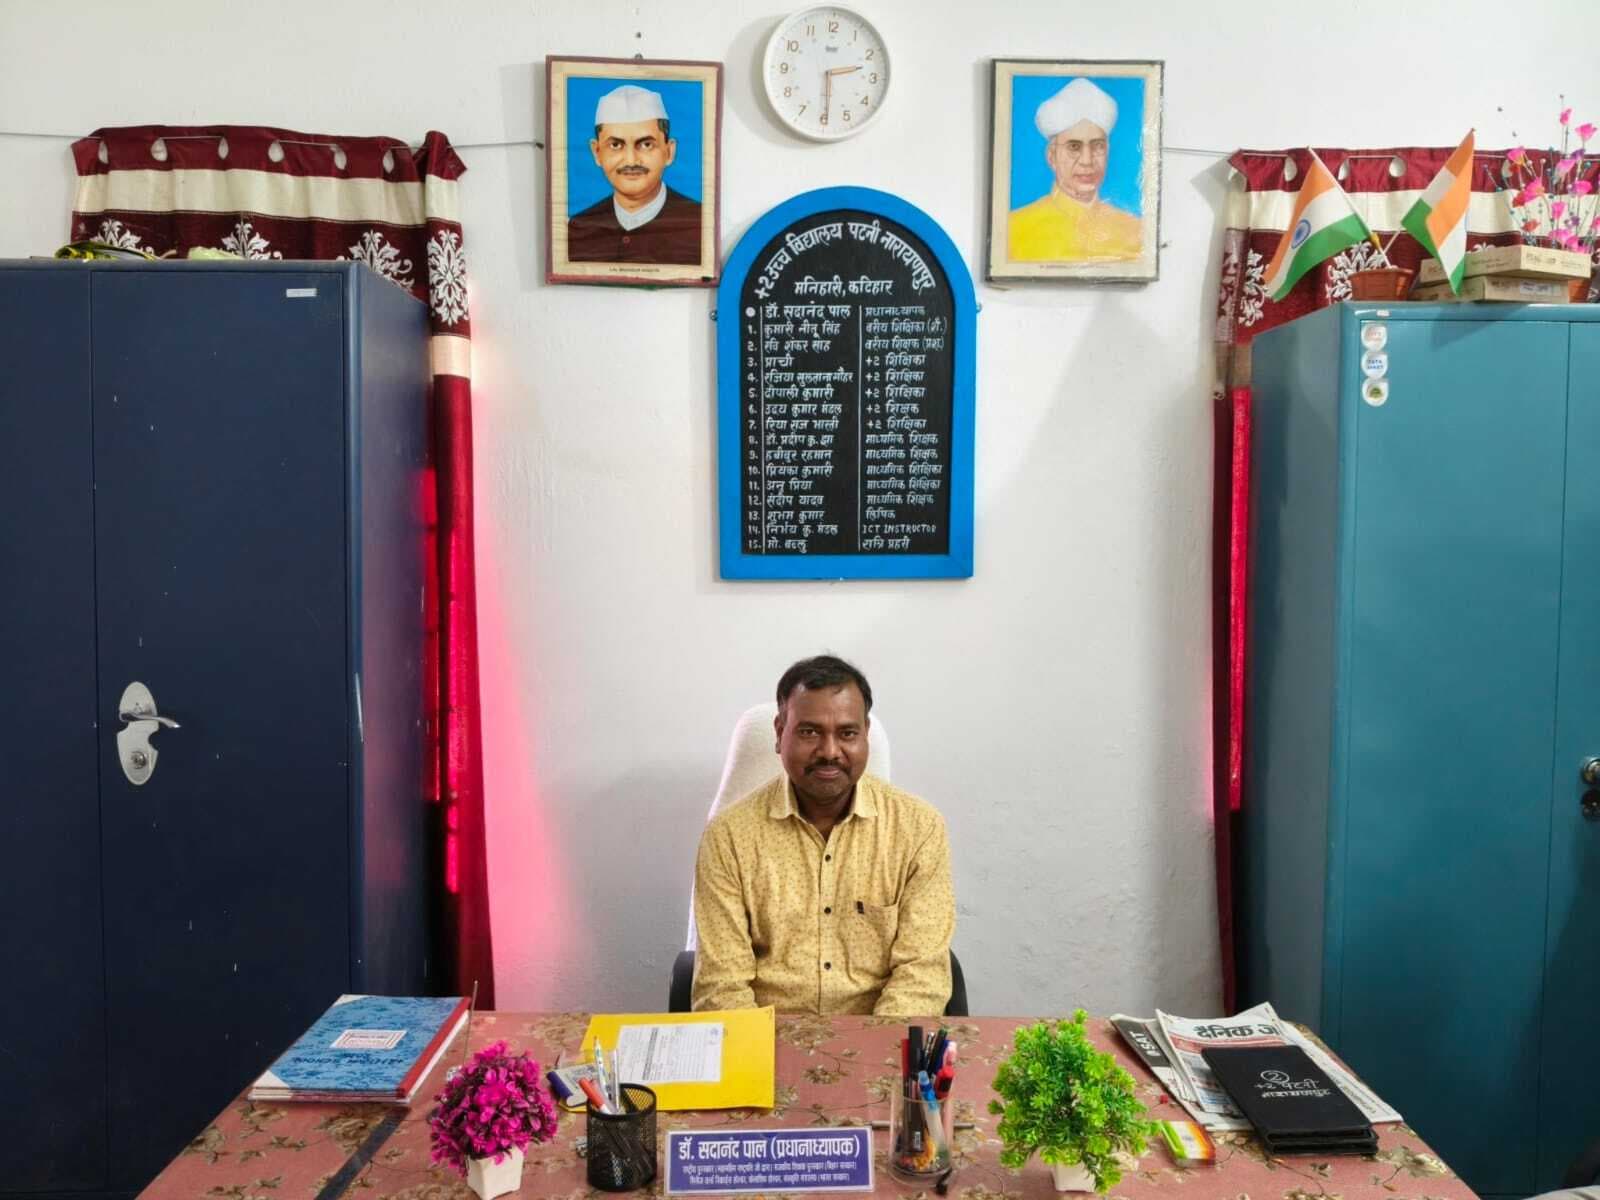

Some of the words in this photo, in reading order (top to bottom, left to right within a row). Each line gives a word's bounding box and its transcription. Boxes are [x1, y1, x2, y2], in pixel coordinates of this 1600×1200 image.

[807, 25, 815, 36] 11
[828, 21, 839, 33] 12
[787, 40, 799, 52] 10
[865, 49, 874, 60] 2
[780, 62, 788, 74] 9
[869, 73, 877, 84] 3
[784, 86, 792, 98] 8
[860, 96, 868, 106] 4
[798, 105, 807, 116] 7
[843, 110, 851, 121] 5
[785, 222, 844, 255] विद्यालय
[848, 220, 881, 244] पटनी
[880, 231, 936, 295] नारायणपुर
[794, 274, 846, 297] मनिहारी,
[848, 275, 893, 295] कटिहार
[783, 300, 825, 320] सदानंद
[828, 305, 851, 319] पाल
[764, 322, 794, 338] कुमारी
[822, 320, 841, 335] सिंह
[892, 318, 925, 334] शिक्षिका
[764, 338, 780, 352] रवि
[784, 336, 808, 352] शंकर
[764, 353, 795, 368] प्राची
[866, 355, 880, 367] +2
[885, 352, 926, 367] शिक्षिका
[866, 372, 880, 382] +2
[885, 369, 925, 383] शिक्षिका
[802, 384, 834, 400] कुमारी
[865, 387, 880, 398] +2
[885, 385, 926, 399] शिक्षिका
[765, 404, 787, 415] उदय
[792, 403, 817, 417] कुमार
[866, 403, 881, 414] +2
[886, 400, 920, 415] शिक्षक
[765, 417, 787, 430] रिया
[867, 419, 881, 429] +2
[888, 416, 927, 430] शिक्षिका
[909, 431, 938, 446] शिक्षक
[910, 446, 938, 460] शिक्षक
[801, 461, 834, 478] कुमारी
[908, 462, 942, 476] शिक्षिका
[789, 478, 813, 490] प्रिया
[908, 477, 941, 490] शिक्षिका
[799, 495, 824, 505] यादव
[907, 491, 934, 505] शिक्षक
[799, 510, 825, 523] कुमार
[862, 525, 881, 534] ICT
[1194, 1024, 1254, 1038] दैनिक
[679, 1137, 695, 1160] डॉ.
[699, 1137, 740, 1160] सदानंद
[743, 1138, 767, 1158] पाल
[771, 1135, 860, 1160] (प्रधानाध्यापक)
